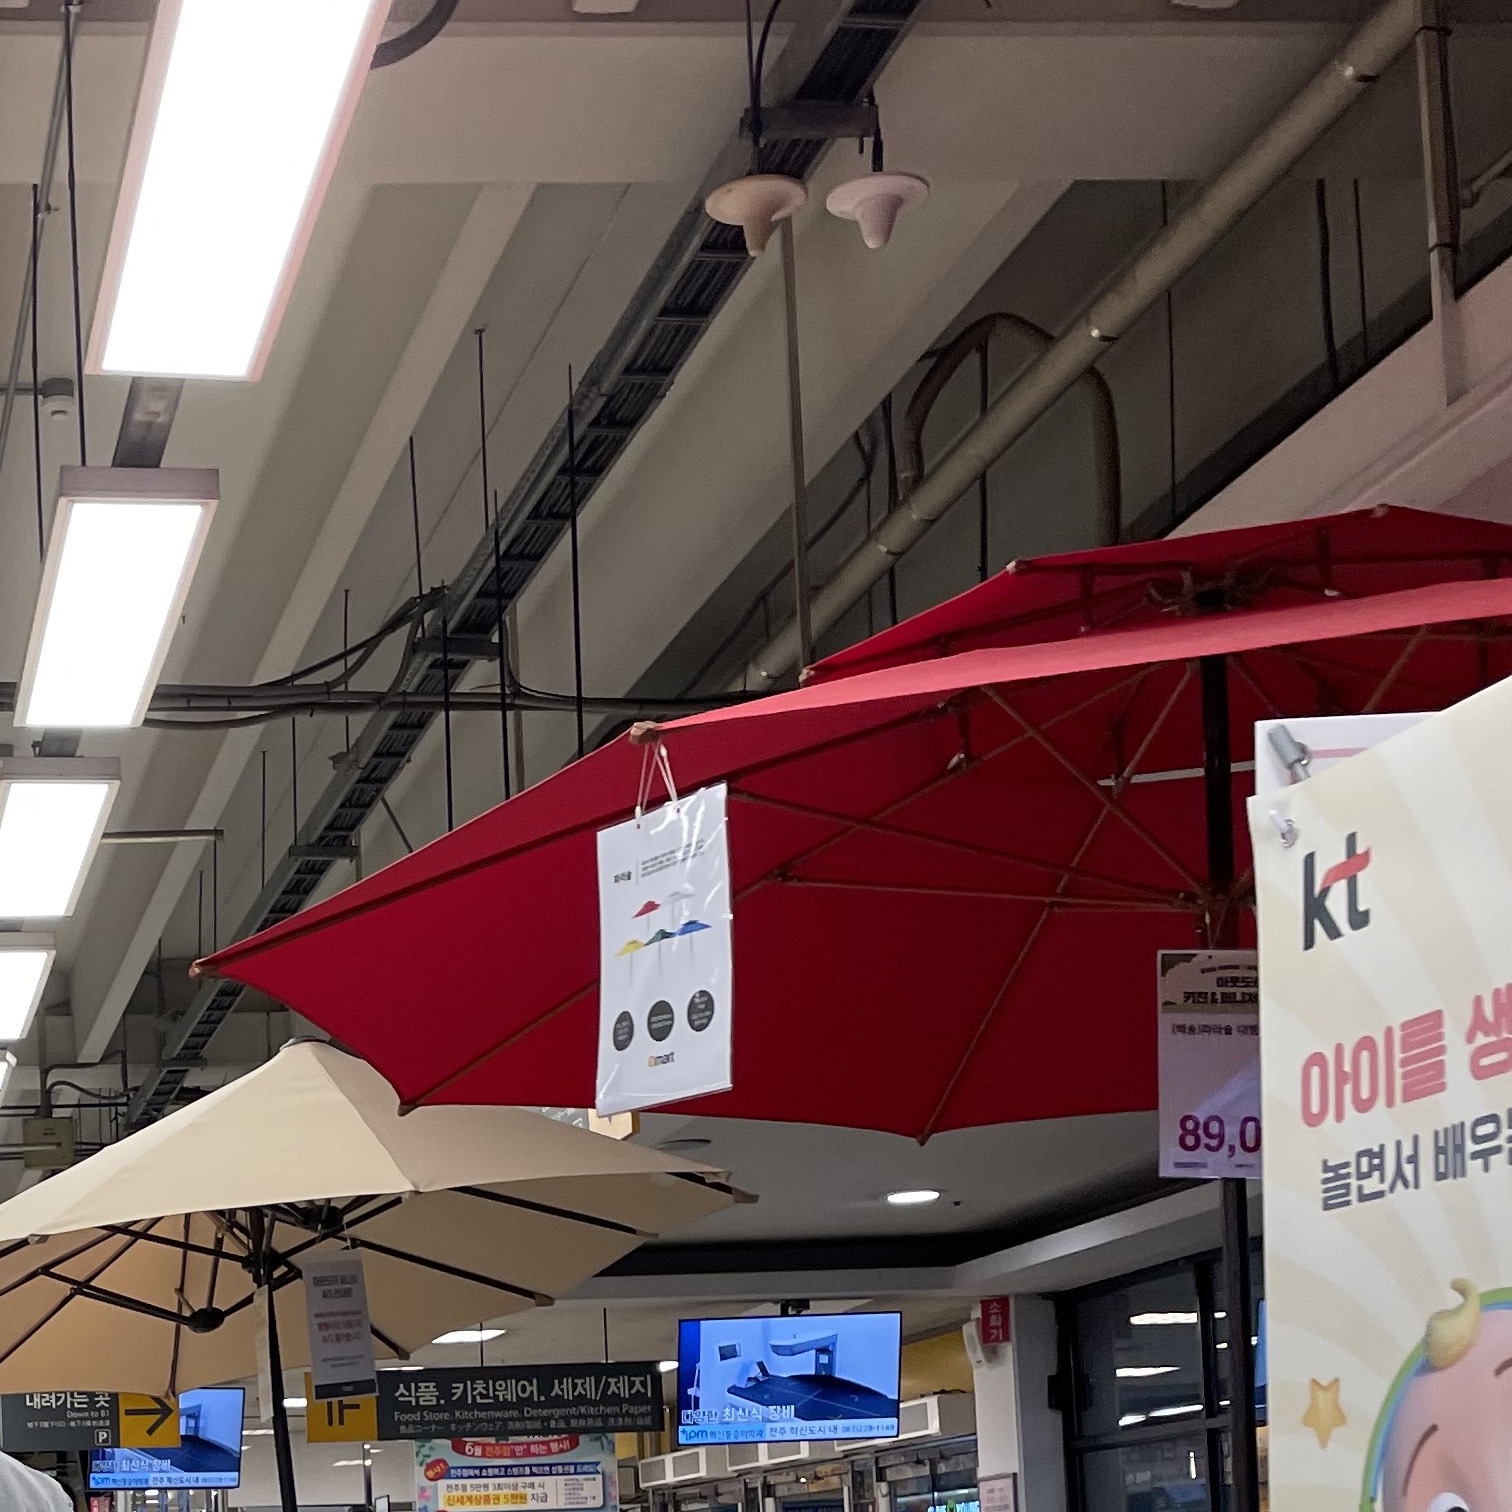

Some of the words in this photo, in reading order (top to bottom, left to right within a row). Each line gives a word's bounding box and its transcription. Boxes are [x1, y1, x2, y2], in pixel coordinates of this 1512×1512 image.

[1303, 831, 1371, 951] kt
[1300, 1009, 1448, 1128] 아이를
[1321, 1134, 1420, 1212] 놀면서
[1434, 1107, 1512, 1184] 배우
[989, 1301, 1004, 1342] 소화기
[551, 1374, 653, 1401] 세제/제지
[25, 1391, 90, 1410] 내려가는
[94, 1391, 112, 1408] 곳
[394, 1411, 420, 1422] Food
[622, 1404, 653, 1416] Paper
[723, 1406, 763, 1422] 최신식
[768, 1405, 795, 1420] 장비
[790, 1425, 826, 1436] 혁신도시
[120, 1459, 148, 1472] 최신식
[152, 1459, 171, 1472] 장비
[530, 1492, 548, 1504] 지급
